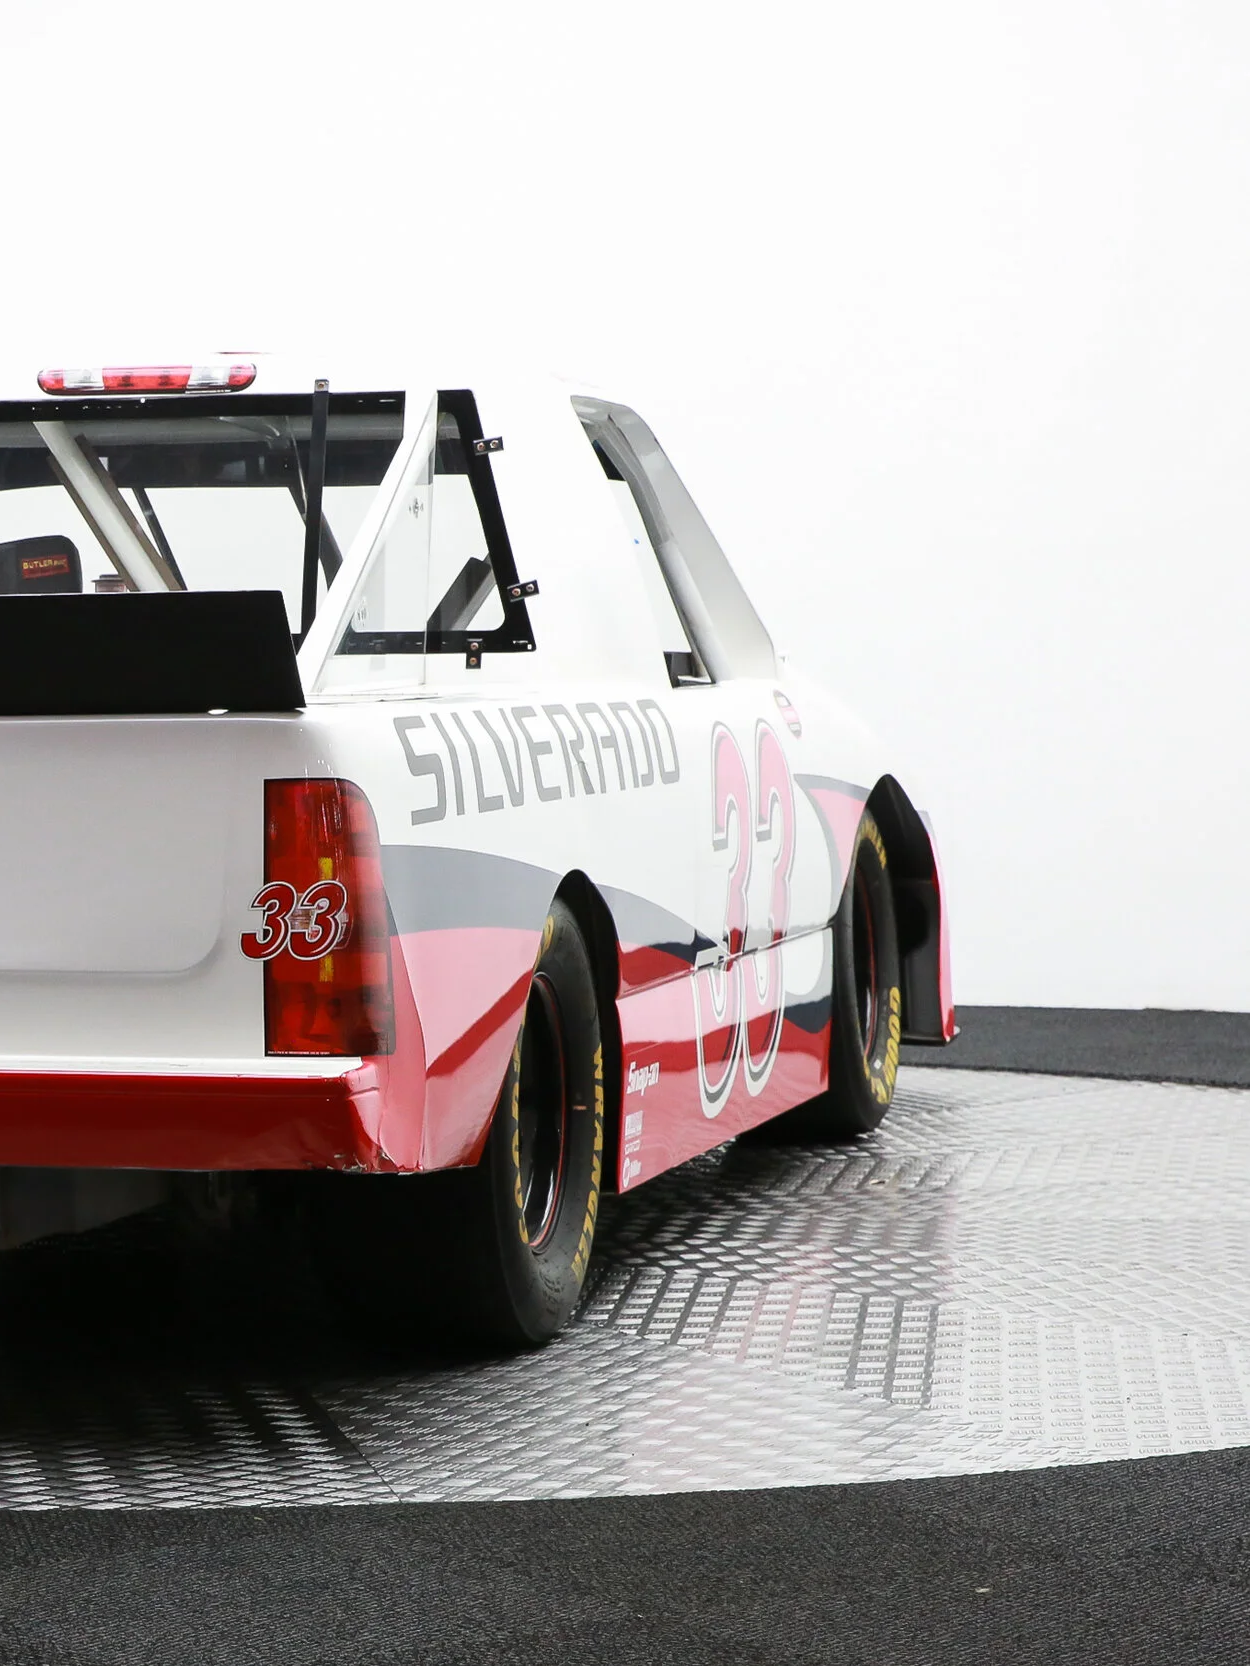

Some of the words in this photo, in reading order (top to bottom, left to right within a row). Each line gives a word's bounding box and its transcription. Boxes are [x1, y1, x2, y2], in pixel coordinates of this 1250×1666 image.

[22, 559, 53, 570] BUTLER
[393, 699, 680, 826] SILVERADO
[240, 879, 347, 961] 33
[693, 718, 796, 1119] 33
[626, 1061, 660, 1096] Snap-on
[571, 1042, 605, 1285] WRANGLER
